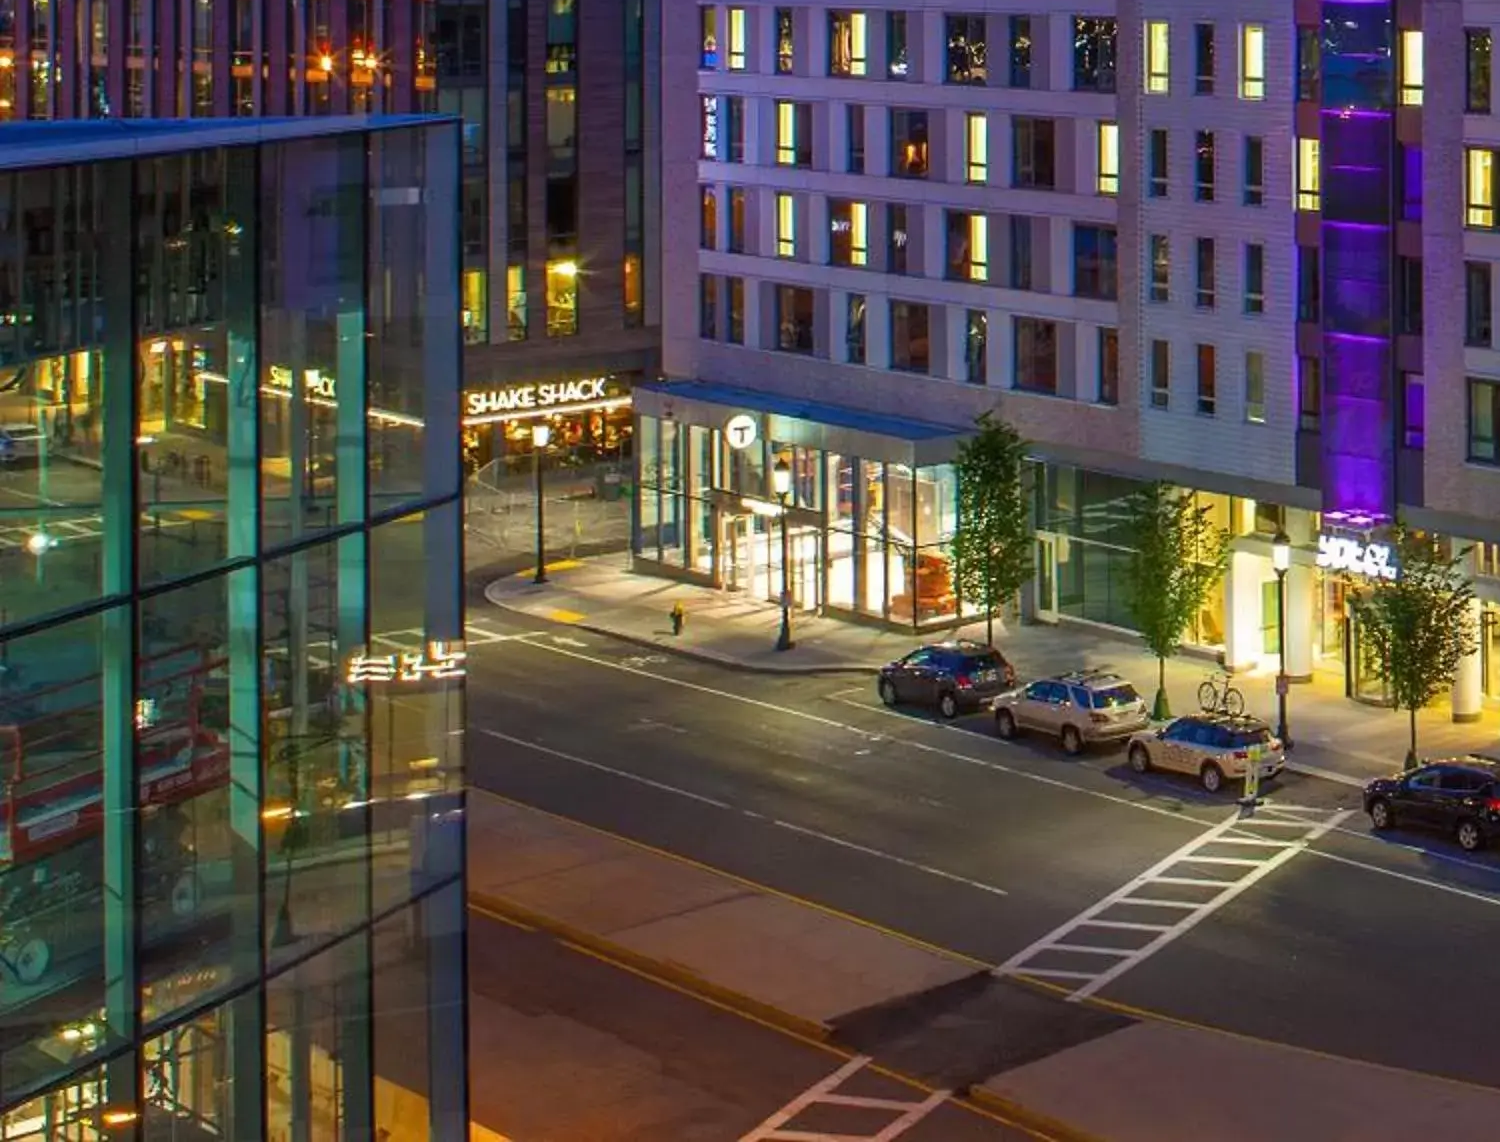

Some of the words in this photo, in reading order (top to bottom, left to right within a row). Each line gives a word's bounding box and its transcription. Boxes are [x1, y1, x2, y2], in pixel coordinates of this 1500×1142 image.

[468, 387, 536, 414] SHAKE
[538, 377, 606, 405] SHACK
[733, 425, 751, 444] T
